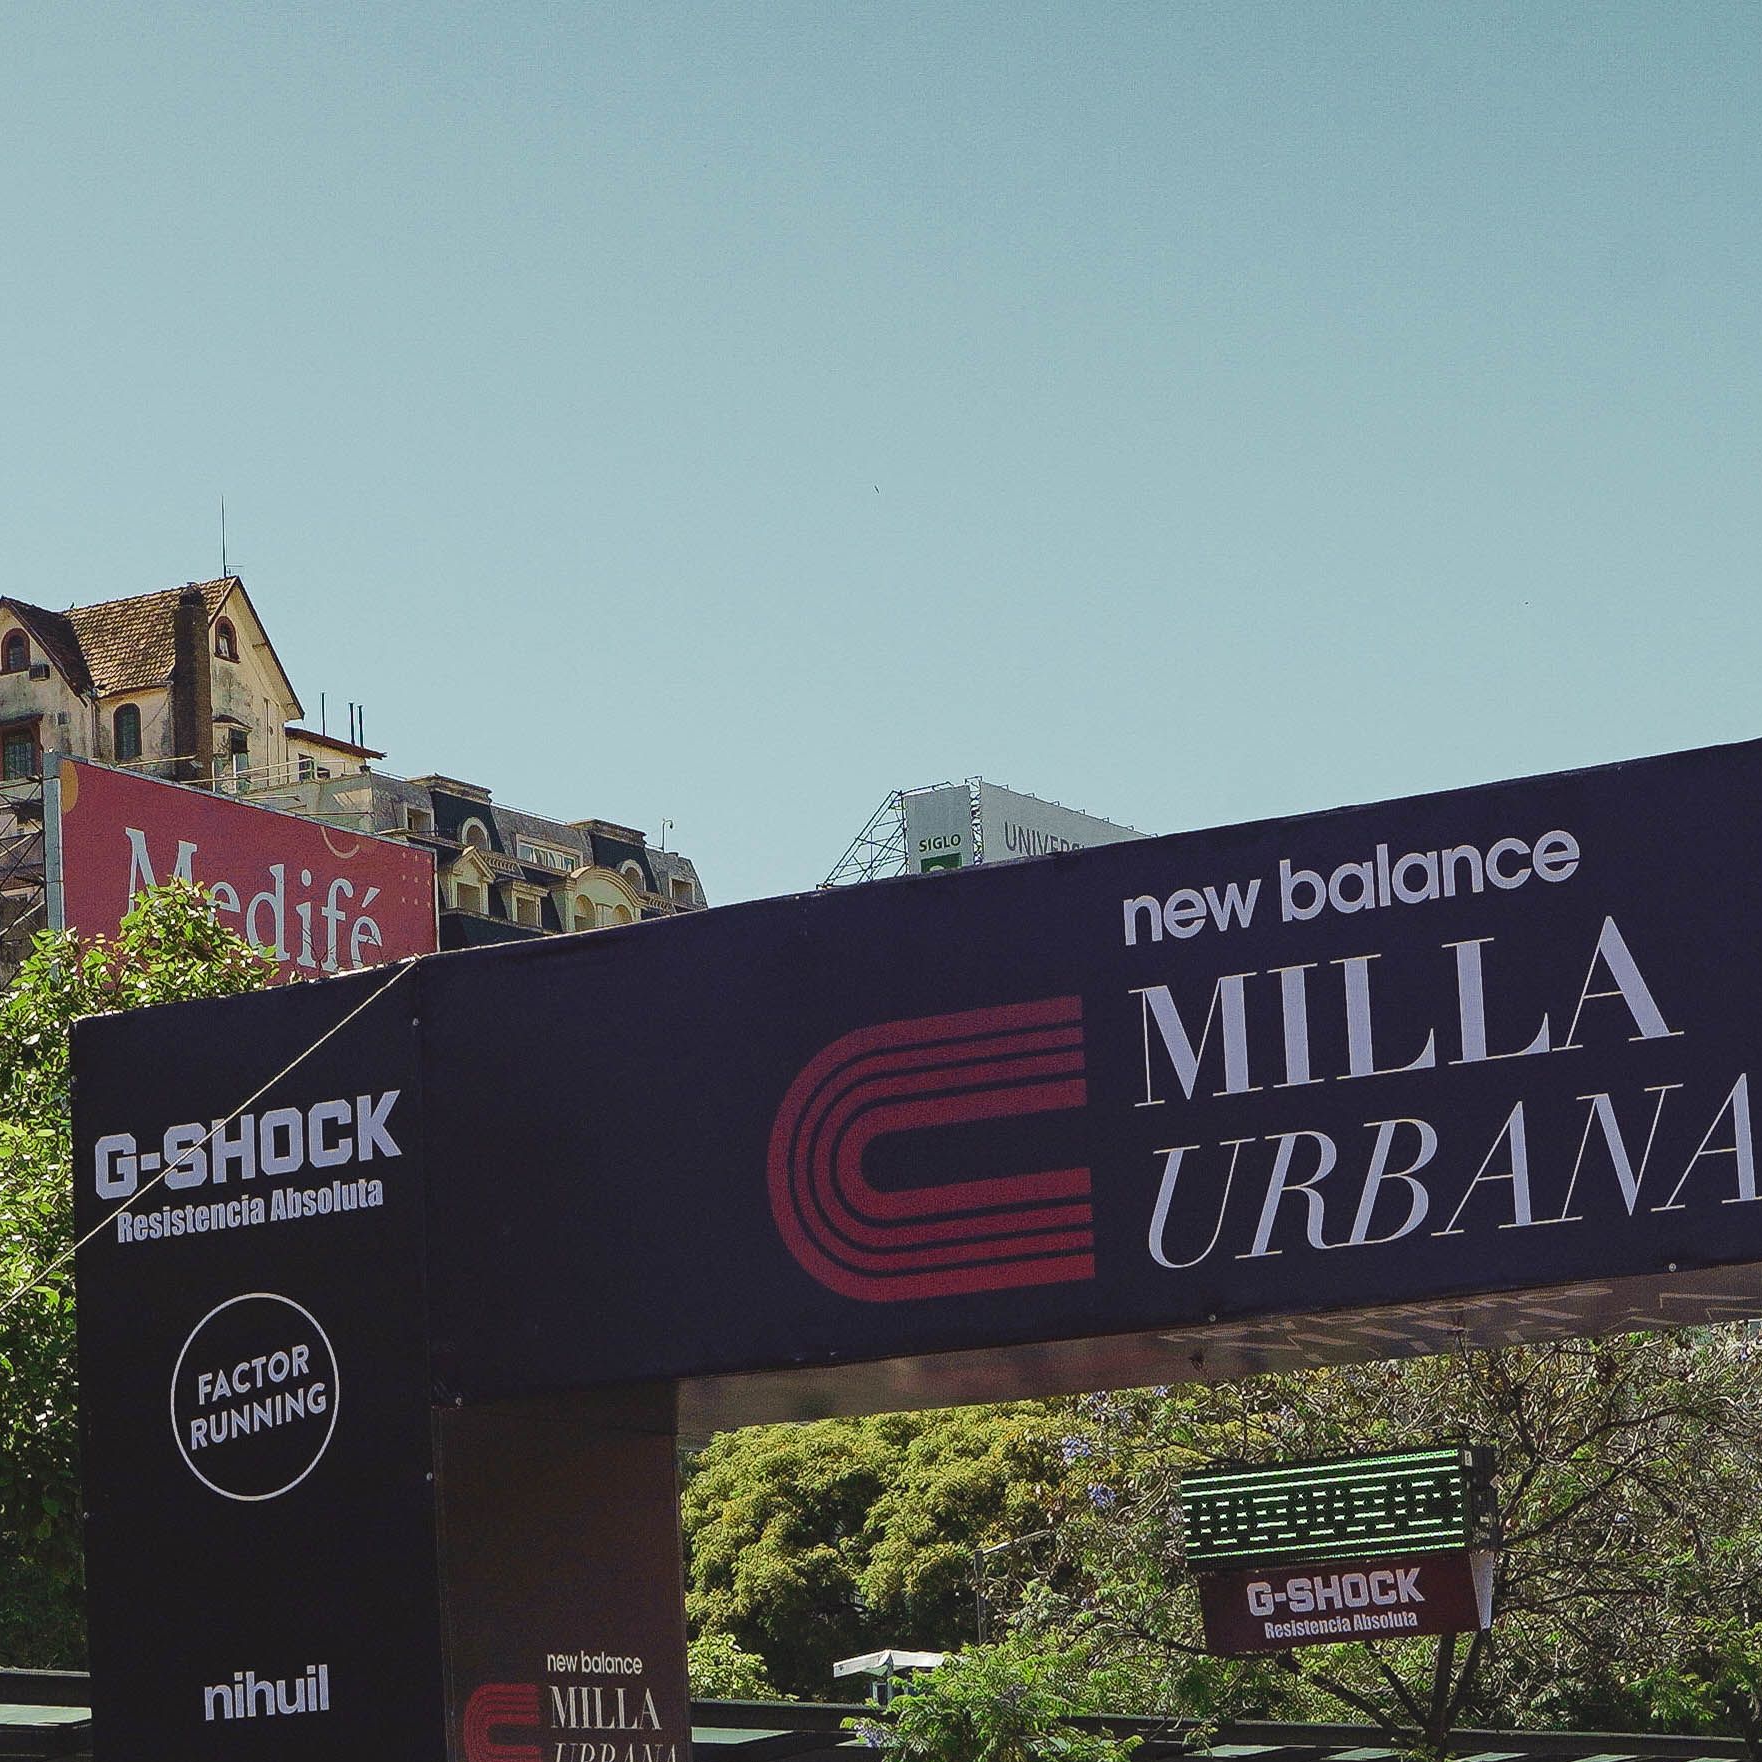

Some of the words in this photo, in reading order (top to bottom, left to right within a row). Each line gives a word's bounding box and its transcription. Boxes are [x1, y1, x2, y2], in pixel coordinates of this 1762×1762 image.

[918, 833, 962, 854] SIGLO
[1003, 821, 1087, 857] UNIVE
[125, 825, 384, 973] Medifé
[1122, 875, 1260, 946] new
[1280, 828, 1580, 923] balance
[1128, 914, 1685, 1108] MILLA
[94, 1089, 403, 1200] G-SHOCK
[116, 1193, 265, 1244] Resistencia
[270, 1175, 384, 1222] Absoluta
[196, 1343, 311, 1406] FACTOR
[189, 1382, 328, 1451] RUNNING
[1246, 1566, 1426, 1618] G-SHOCK
[1263, 1616, 1352, 1640] Resistencia
[1352, 1610, 1419, 1634] Absoluta
[203, 1663, 330, 1722] nihuil
[546, 1652, 579, 1675] new
[580, 1650, 644, 1676] balance
[548, 1683, 663, 1731] MILLA
